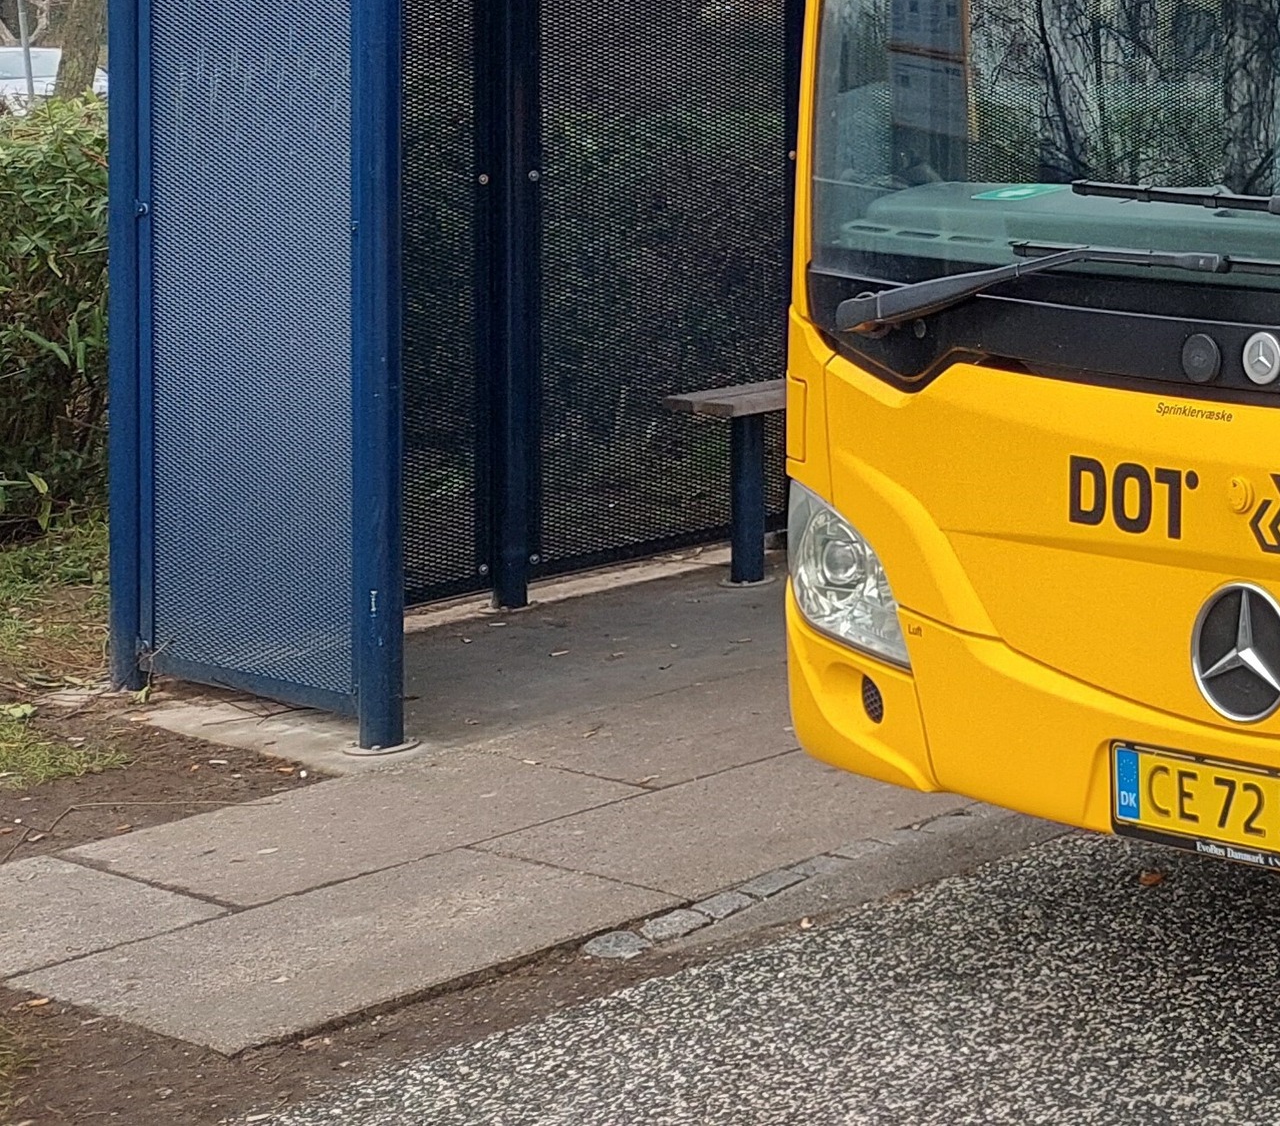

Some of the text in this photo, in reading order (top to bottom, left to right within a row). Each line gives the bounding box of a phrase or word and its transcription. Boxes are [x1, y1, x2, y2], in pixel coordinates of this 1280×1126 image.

[1156, 401, 1233, 423] Sprinklervæske
[1120, 790, 1137, 809] DK
[1148, 764, 1200, 824] CE
[1213, 775, 1267, 838] 72
